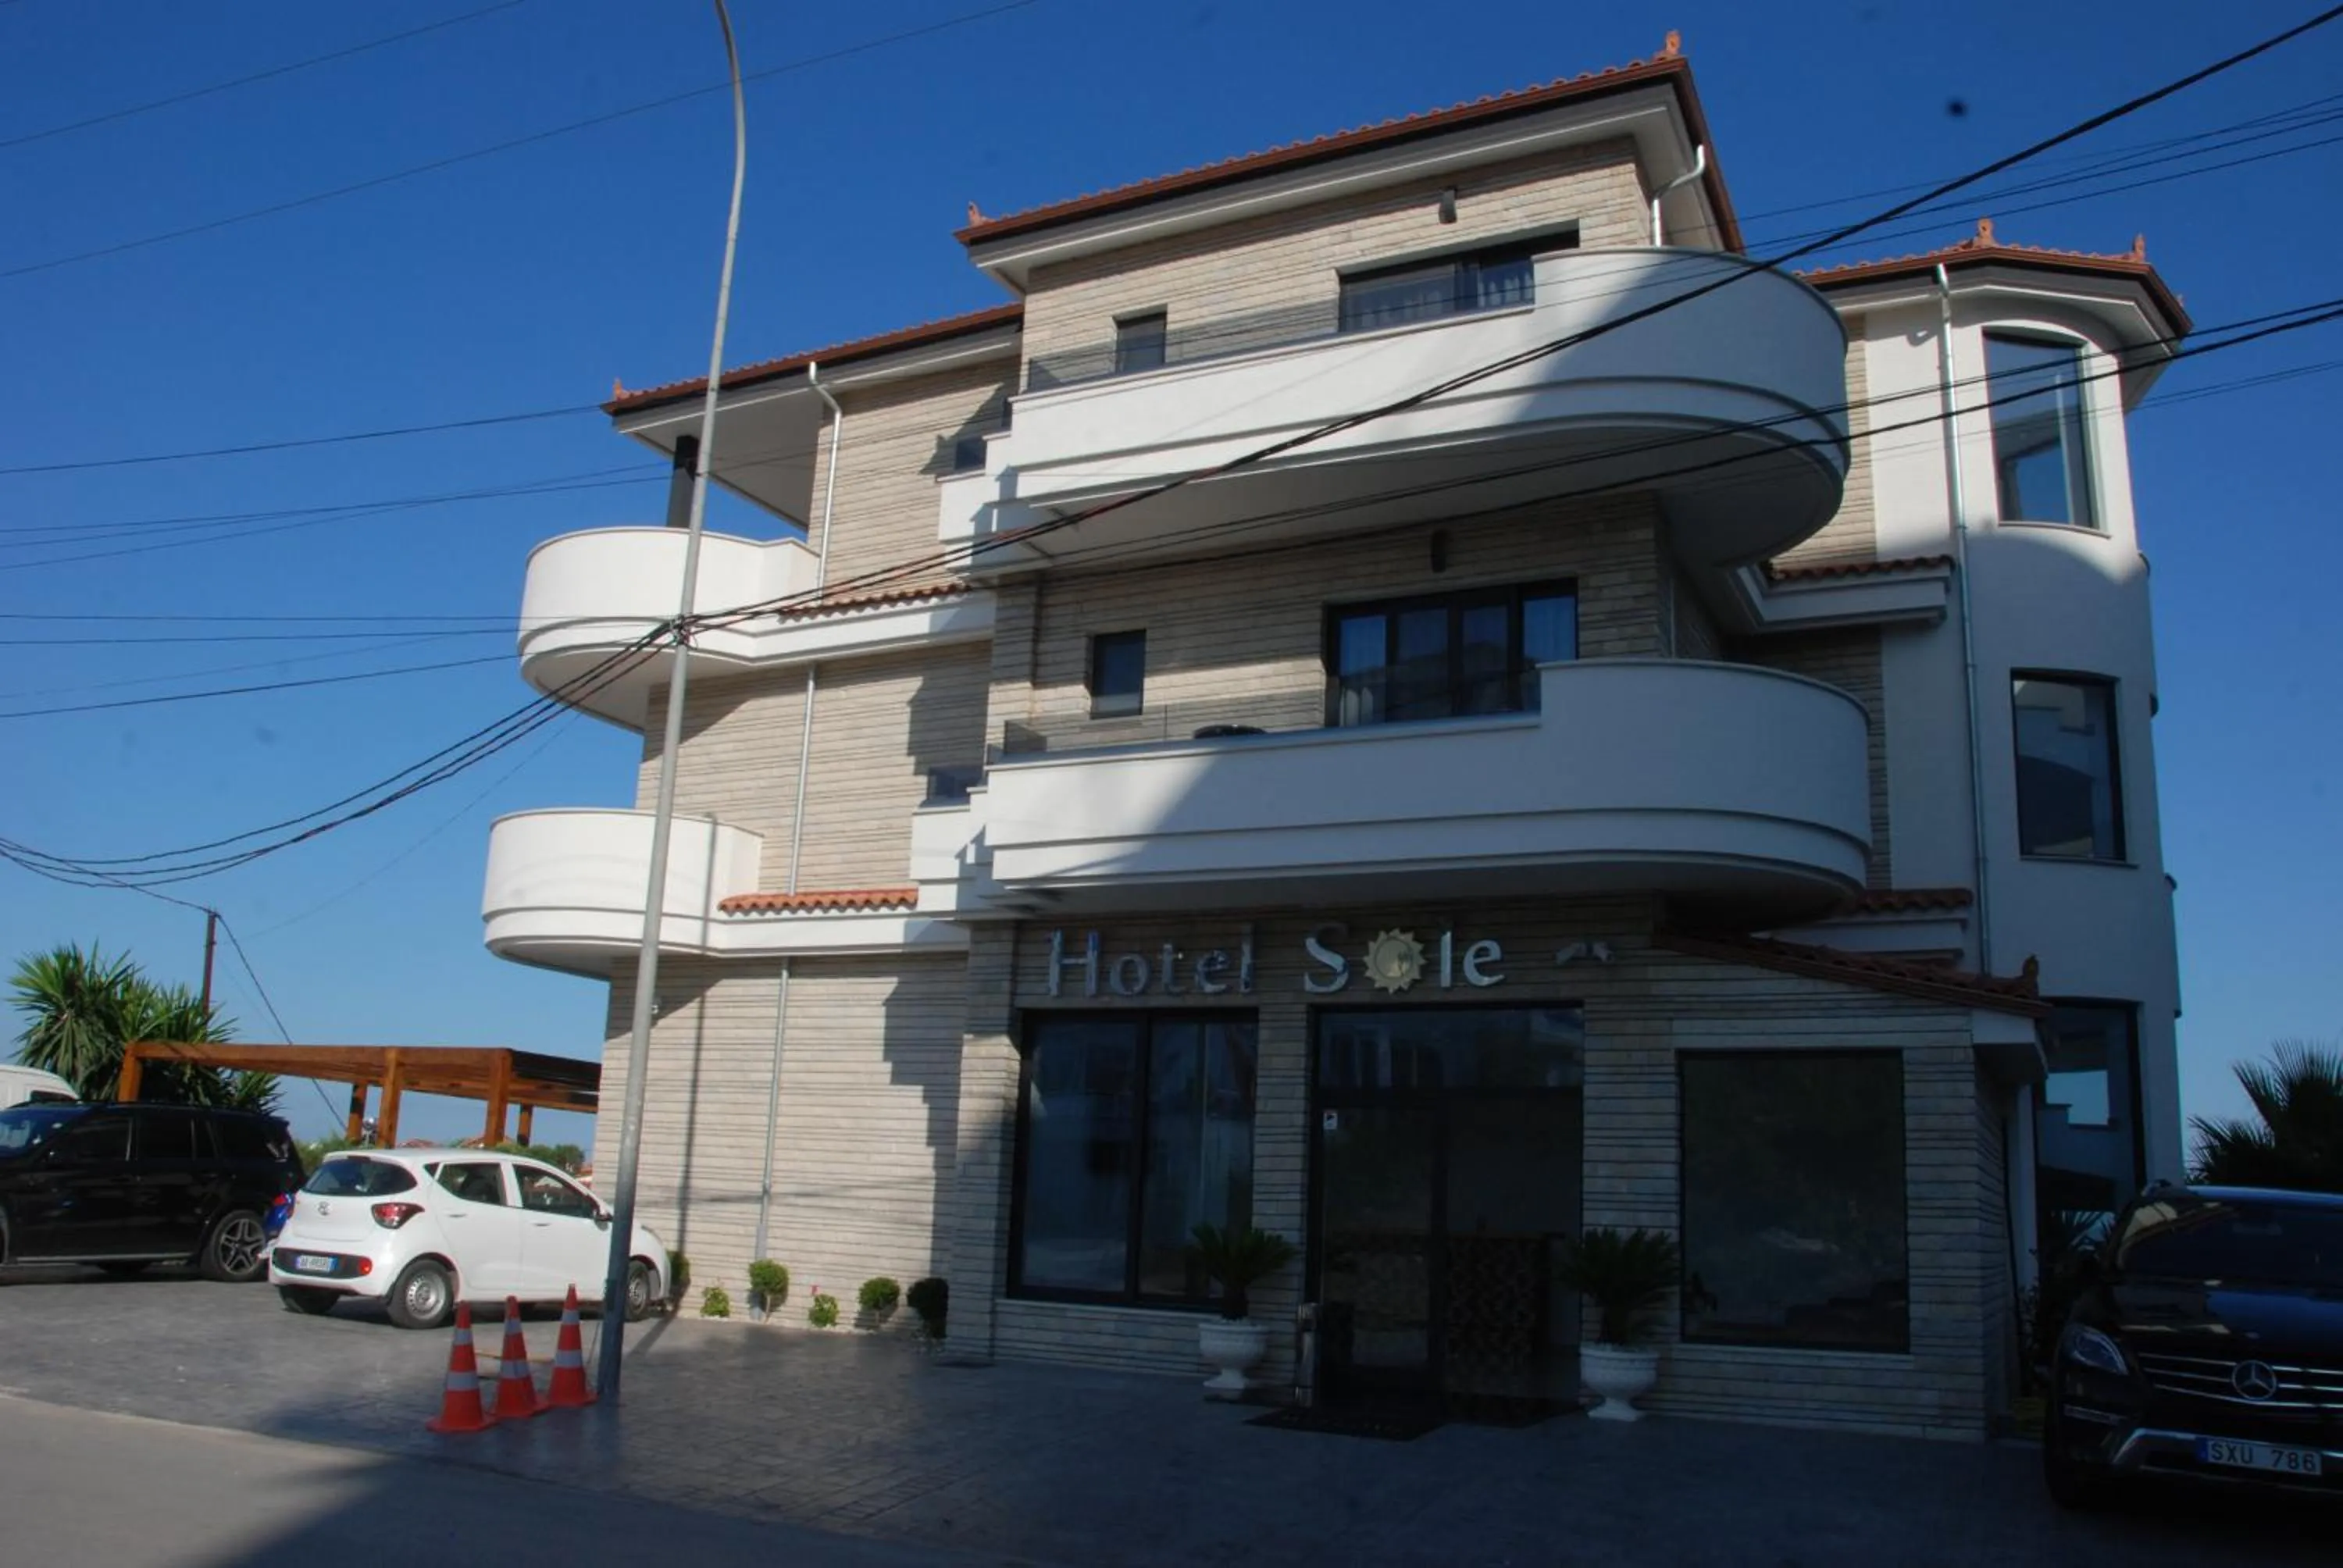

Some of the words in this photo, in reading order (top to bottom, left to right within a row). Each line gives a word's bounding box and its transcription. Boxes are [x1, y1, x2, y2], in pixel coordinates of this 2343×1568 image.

[1048, 923, 1254, 997] Hotel
[1303, 921, 1506, 995] Sole
[2211, 1442, 2253, 1464] SXU
